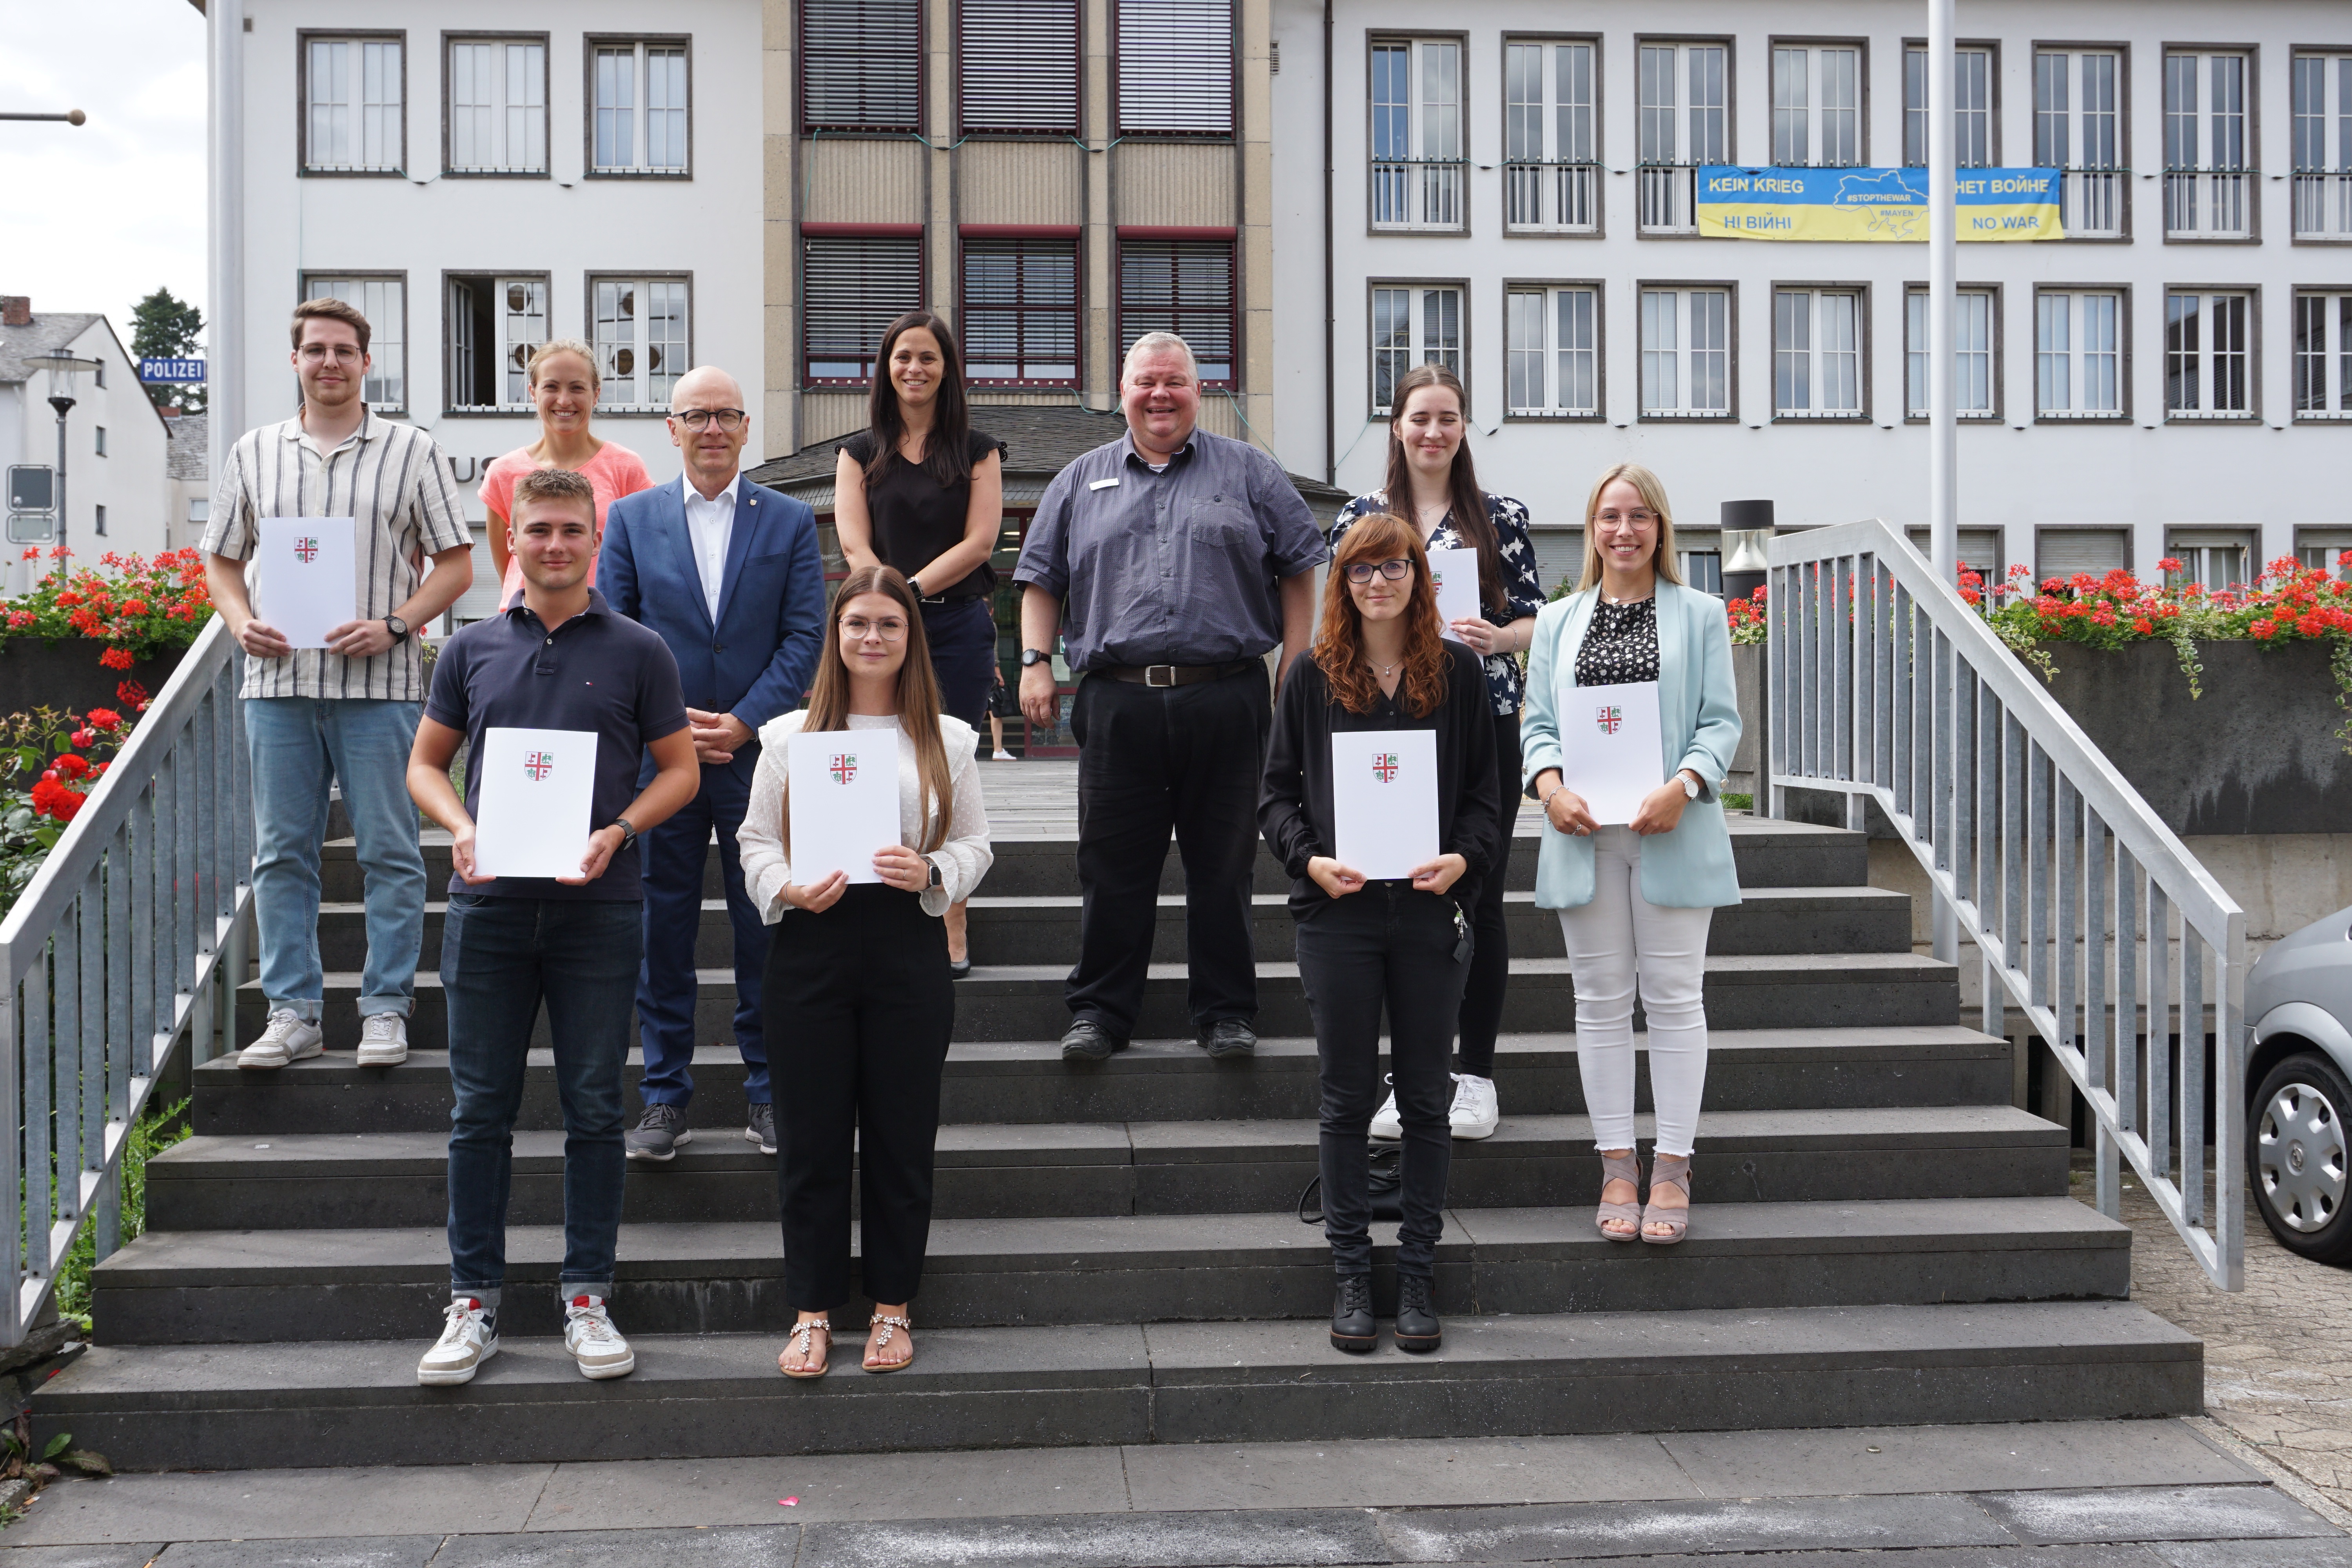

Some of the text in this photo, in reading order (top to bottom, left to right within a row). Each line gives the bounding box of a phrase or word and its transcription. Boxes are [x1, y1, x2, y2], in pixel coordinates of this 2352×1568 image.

[1709, 178, 1804, 193] KEIN KRIEG
[1955, 175, 2049, 194] НЕТ ВОЙНЕ
[1847, 194, 1911, 202] #STOPTHEWAR
[1724, 212, 1791, 229] НІ ВІЙНІ
[1973, 216, 2040, 229] NO WAR
[144, 362, 201, 377] POLIZEI
